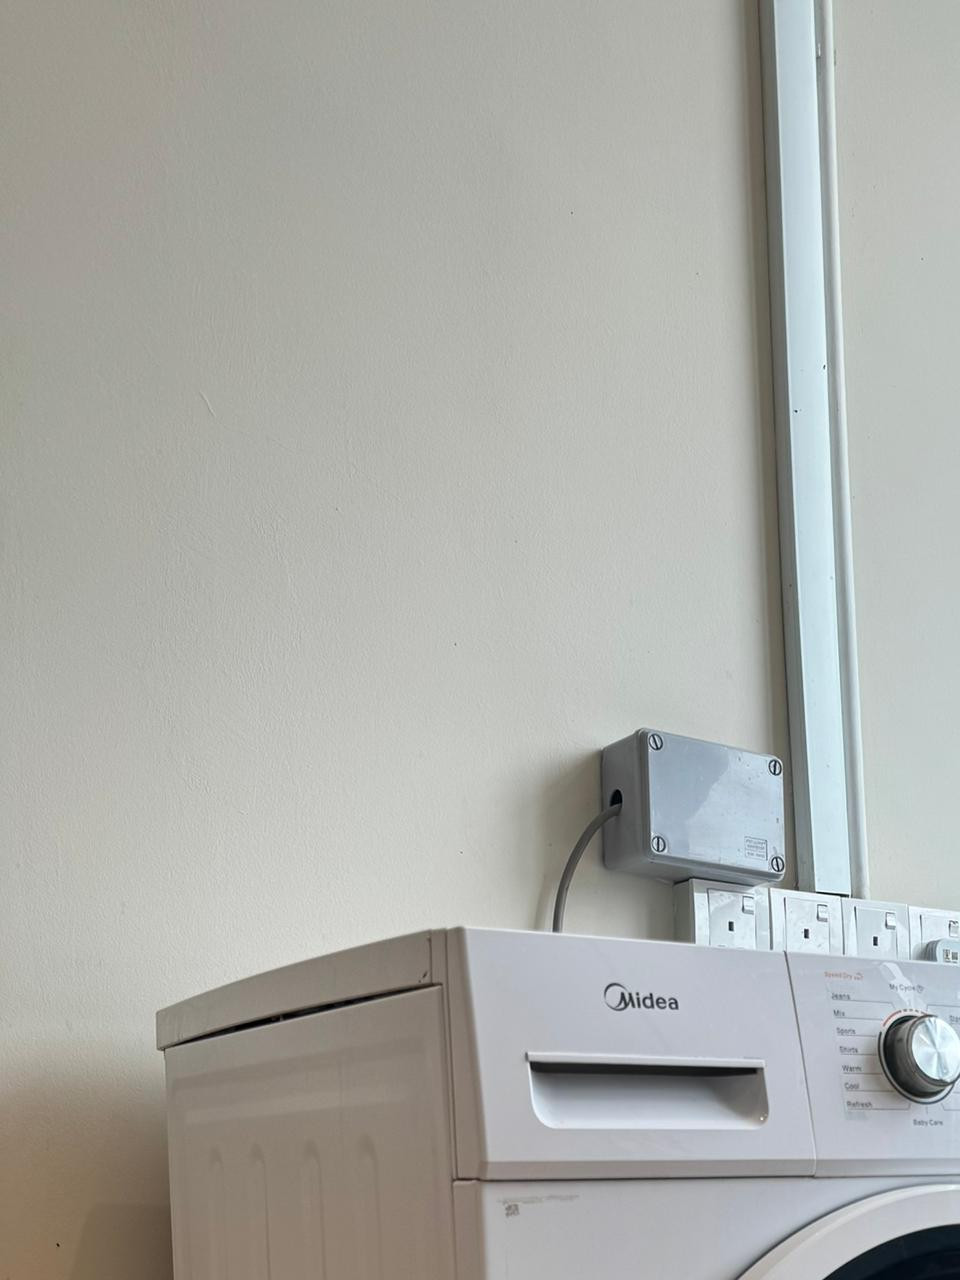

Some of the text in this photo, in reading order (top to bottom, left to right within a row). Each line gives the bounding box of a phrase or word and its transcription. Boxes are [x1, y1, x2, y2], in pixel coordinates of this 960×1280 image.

[604, 982, 679, 1012] Midea
[833, 1009, 846, 1017] Mix
[842, 1065, 862, 1073] Warm
[844, 1082, 859, 1090] Cool
[913, 1119, 928, 1127] Baby
